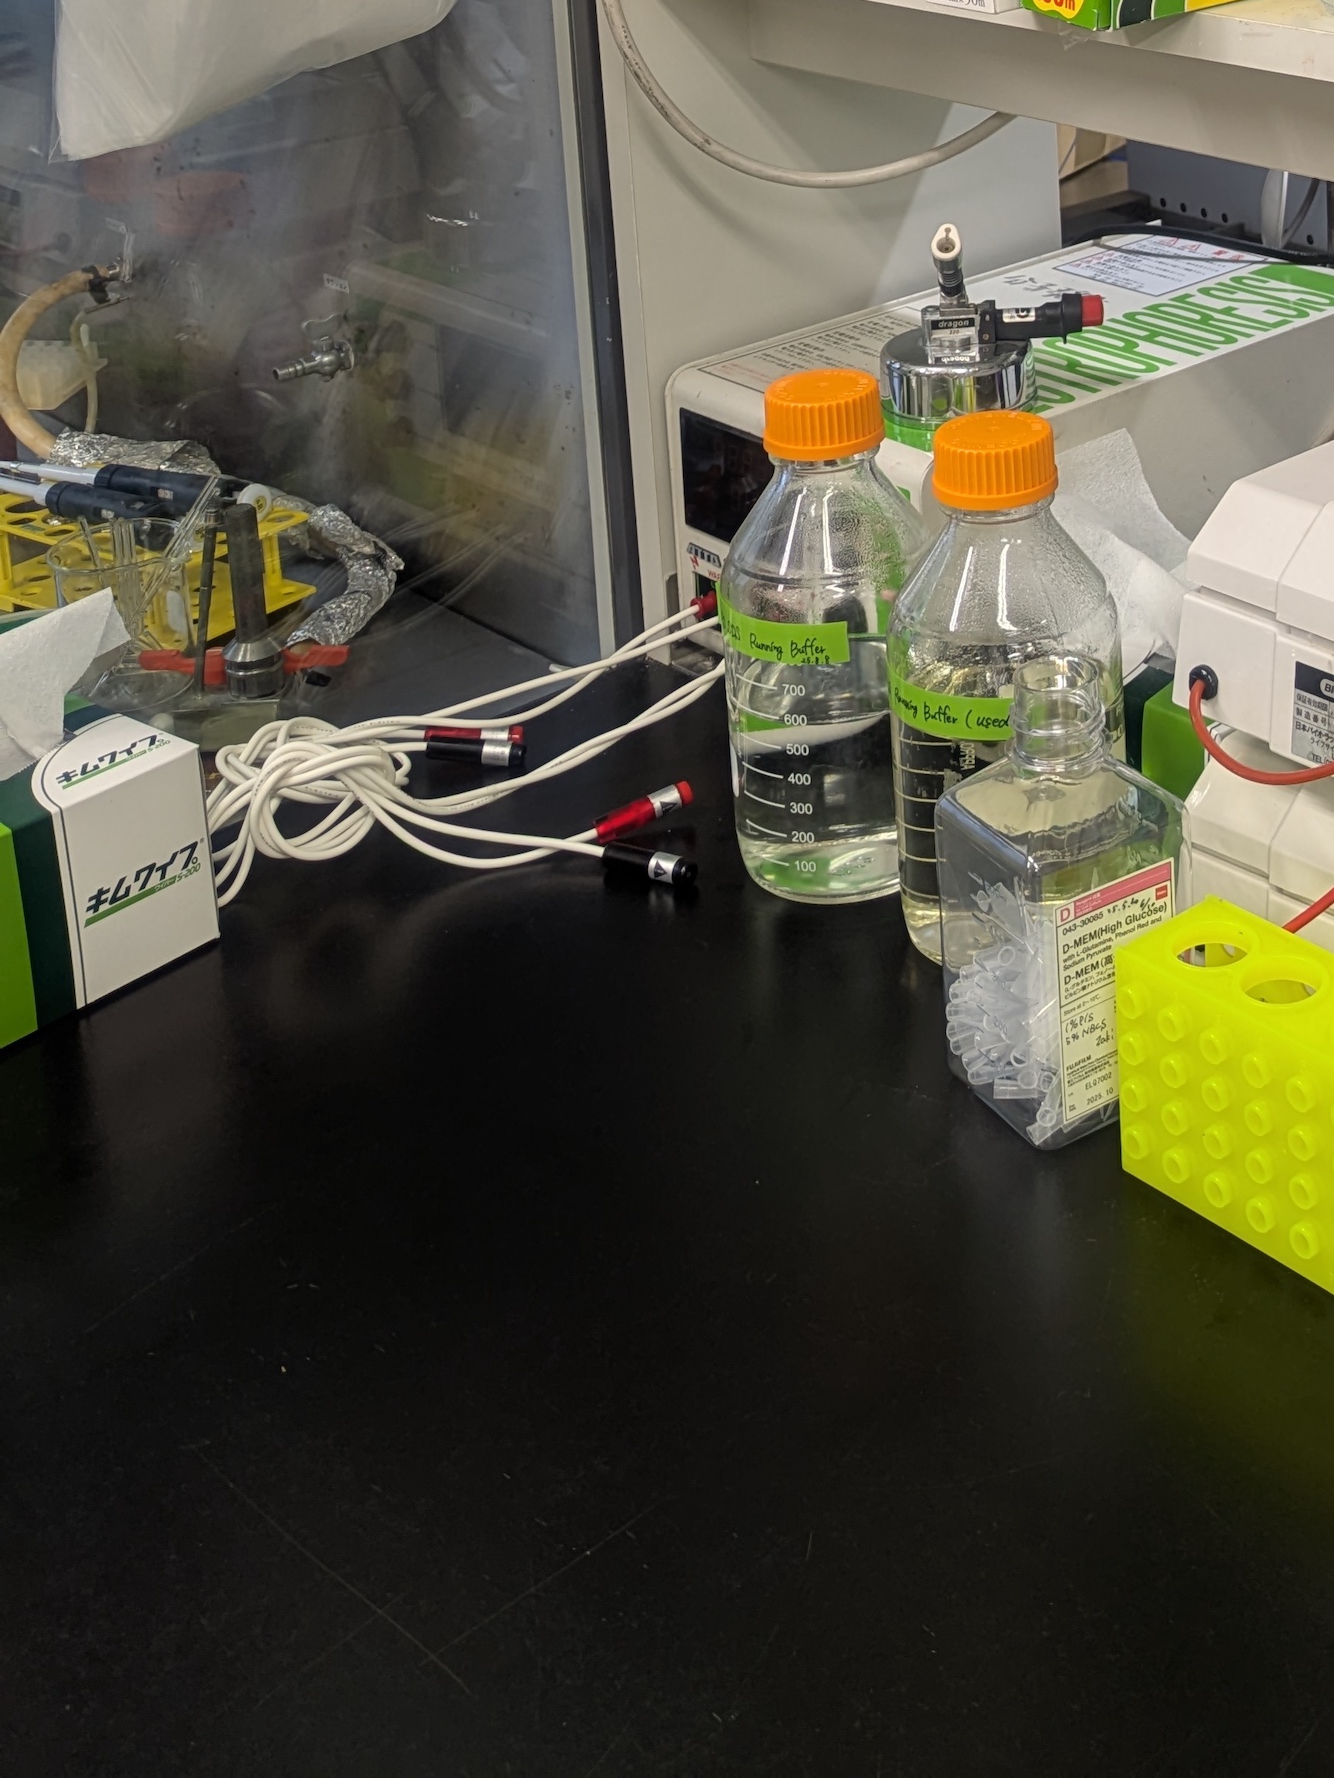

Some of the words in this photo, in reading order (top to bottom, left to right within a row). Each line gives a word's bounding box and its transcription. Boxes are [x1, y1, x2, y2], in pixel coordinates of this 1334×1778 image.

[938, 319, 970, 329] dragon
[750, 633, 784, 661] Running
[790, 638, 827, 658] Buffer
[781, 684, 806, 697] 700
[783, 714, 808, 726] 600
[923, 701, 958, 726] Buffer
[1296, 707, 1327, 727] 製造番号
[785, 744, 810, 757] 500
[55, 734, 165, 785] キムワイプ
[787, 773, 812, 786] 400
[789, 802, 813, 815] 300
[791, 831, 815, 844] 200
[176, 862, 201, 883] S-200
[794, 860, 817, 872] 100
[85, 840, 201, 914] キムワイプ
[1060, 907, 1071, 923] D
[1062, 920, 1122, 955] D-MEM(High
[1125, 900, 1168, 926] Glucose)
[1062, 953, 1076, 964] with
[1115, 927, 1136, 940] Phenol
[1136, 922, 1150, 931] Red
[1150, 915, 1163, 925] and
[1062, 959, 1086, 972] Sodium
[1086, 945, 1112, 961] Pyruvate
[1066, 1054, 1092, 1071] FUJIFILM
